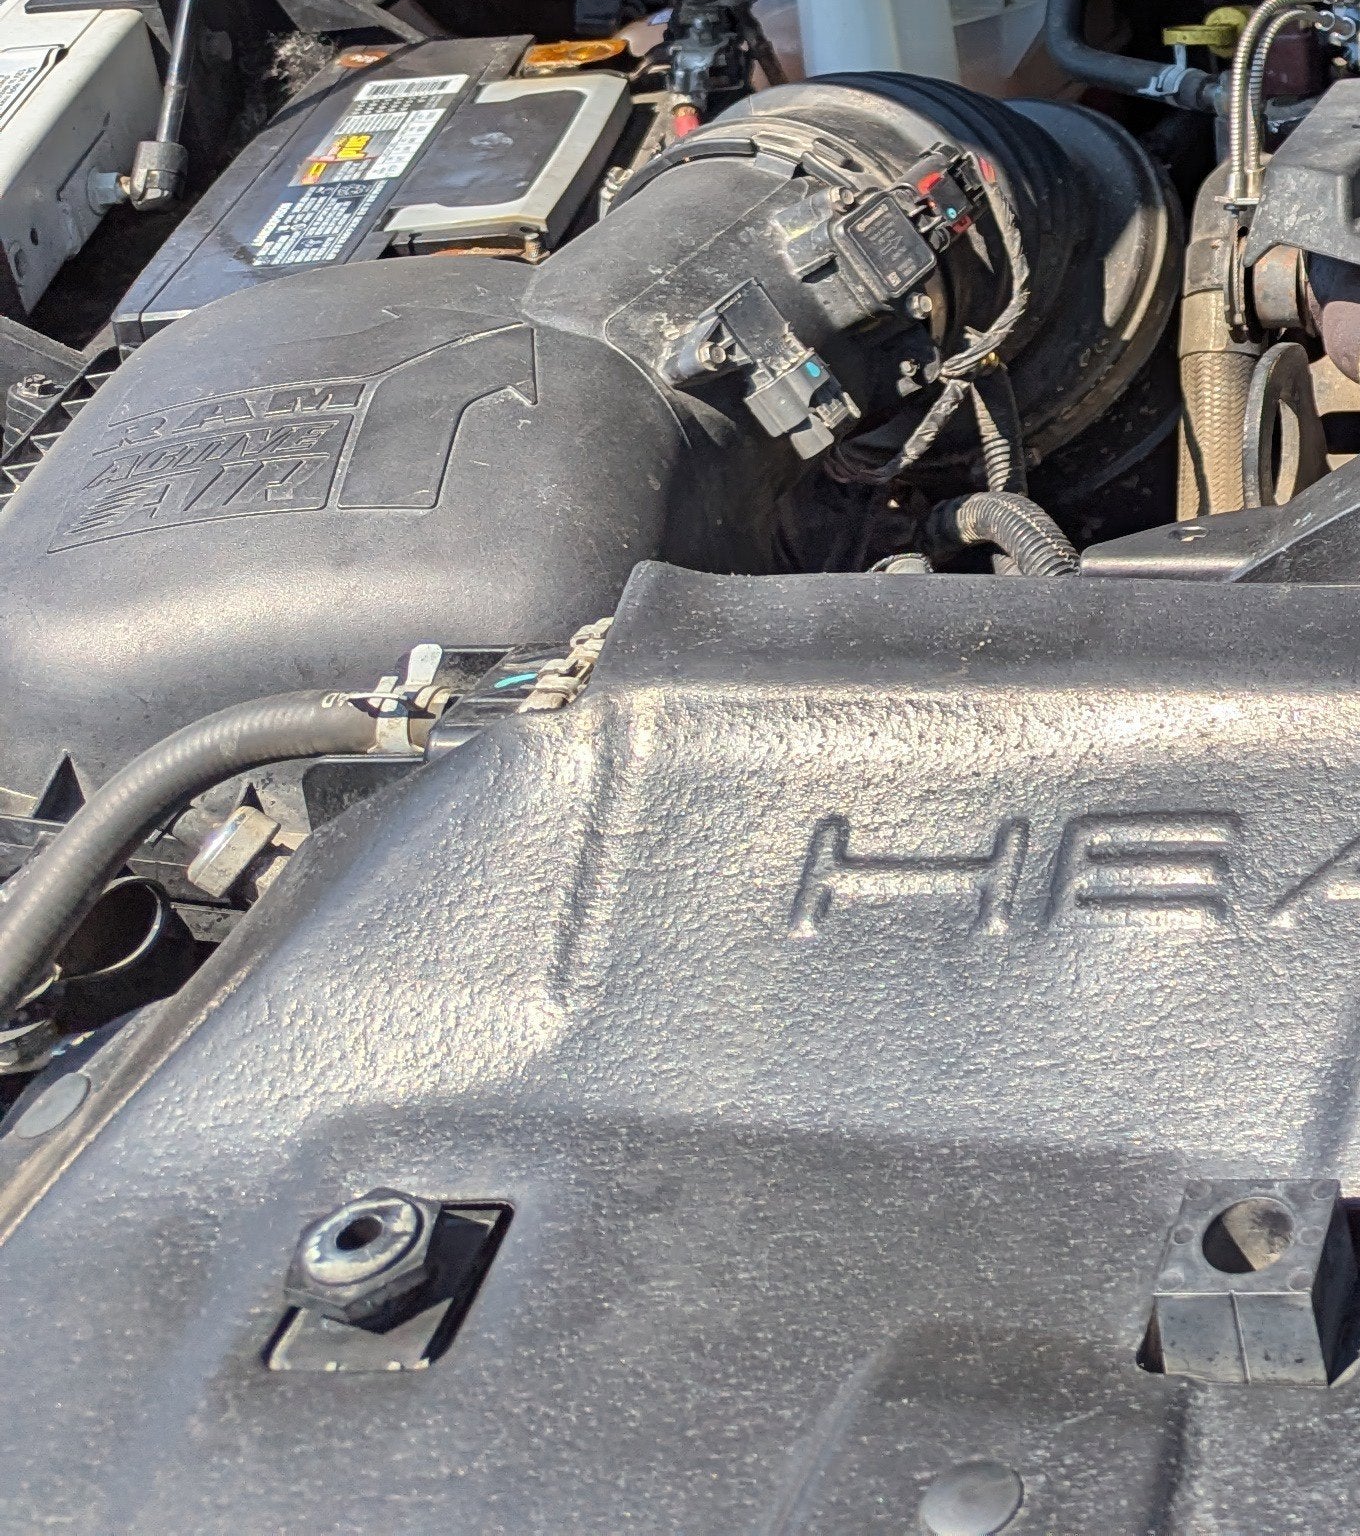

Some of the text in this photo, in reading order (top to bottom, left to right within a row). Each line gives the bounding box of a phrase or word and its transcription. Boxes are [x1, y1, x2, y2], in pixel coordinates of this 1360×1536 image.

[82, 419, 340, 491] ACTIVE
[92, 383, 368, 457] RAM
[64, 454, 332, 535] AIR
